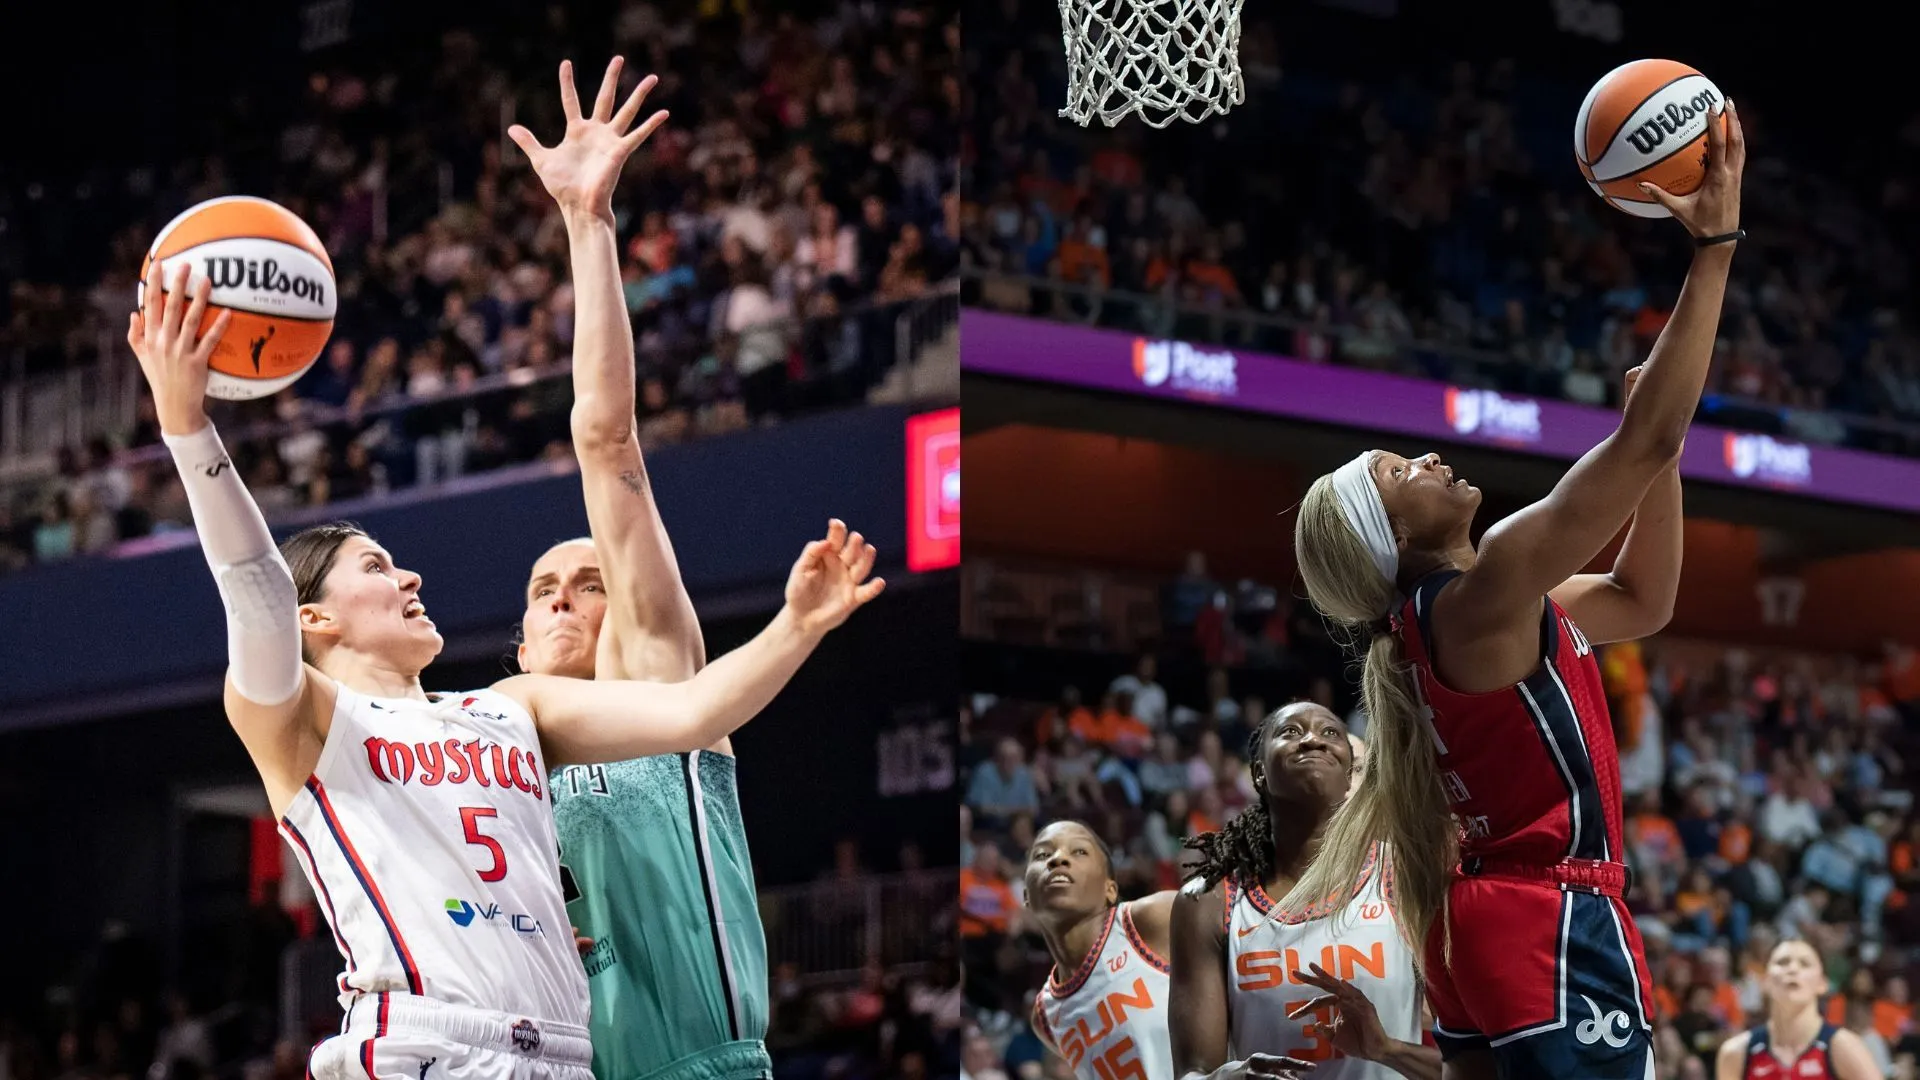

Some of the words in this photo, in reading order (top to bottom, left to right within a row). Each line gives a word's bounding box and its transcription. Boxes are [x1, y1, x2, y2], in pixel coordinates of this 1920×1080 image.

[1625, 88, 1718, 155] Wilson
[204, 256, 325, 306] Wilson
[459, 806, 508, 883] 5
[1236, 942, 1386, 991] SUN
[1061, 976, 1155, 1071] SUN
